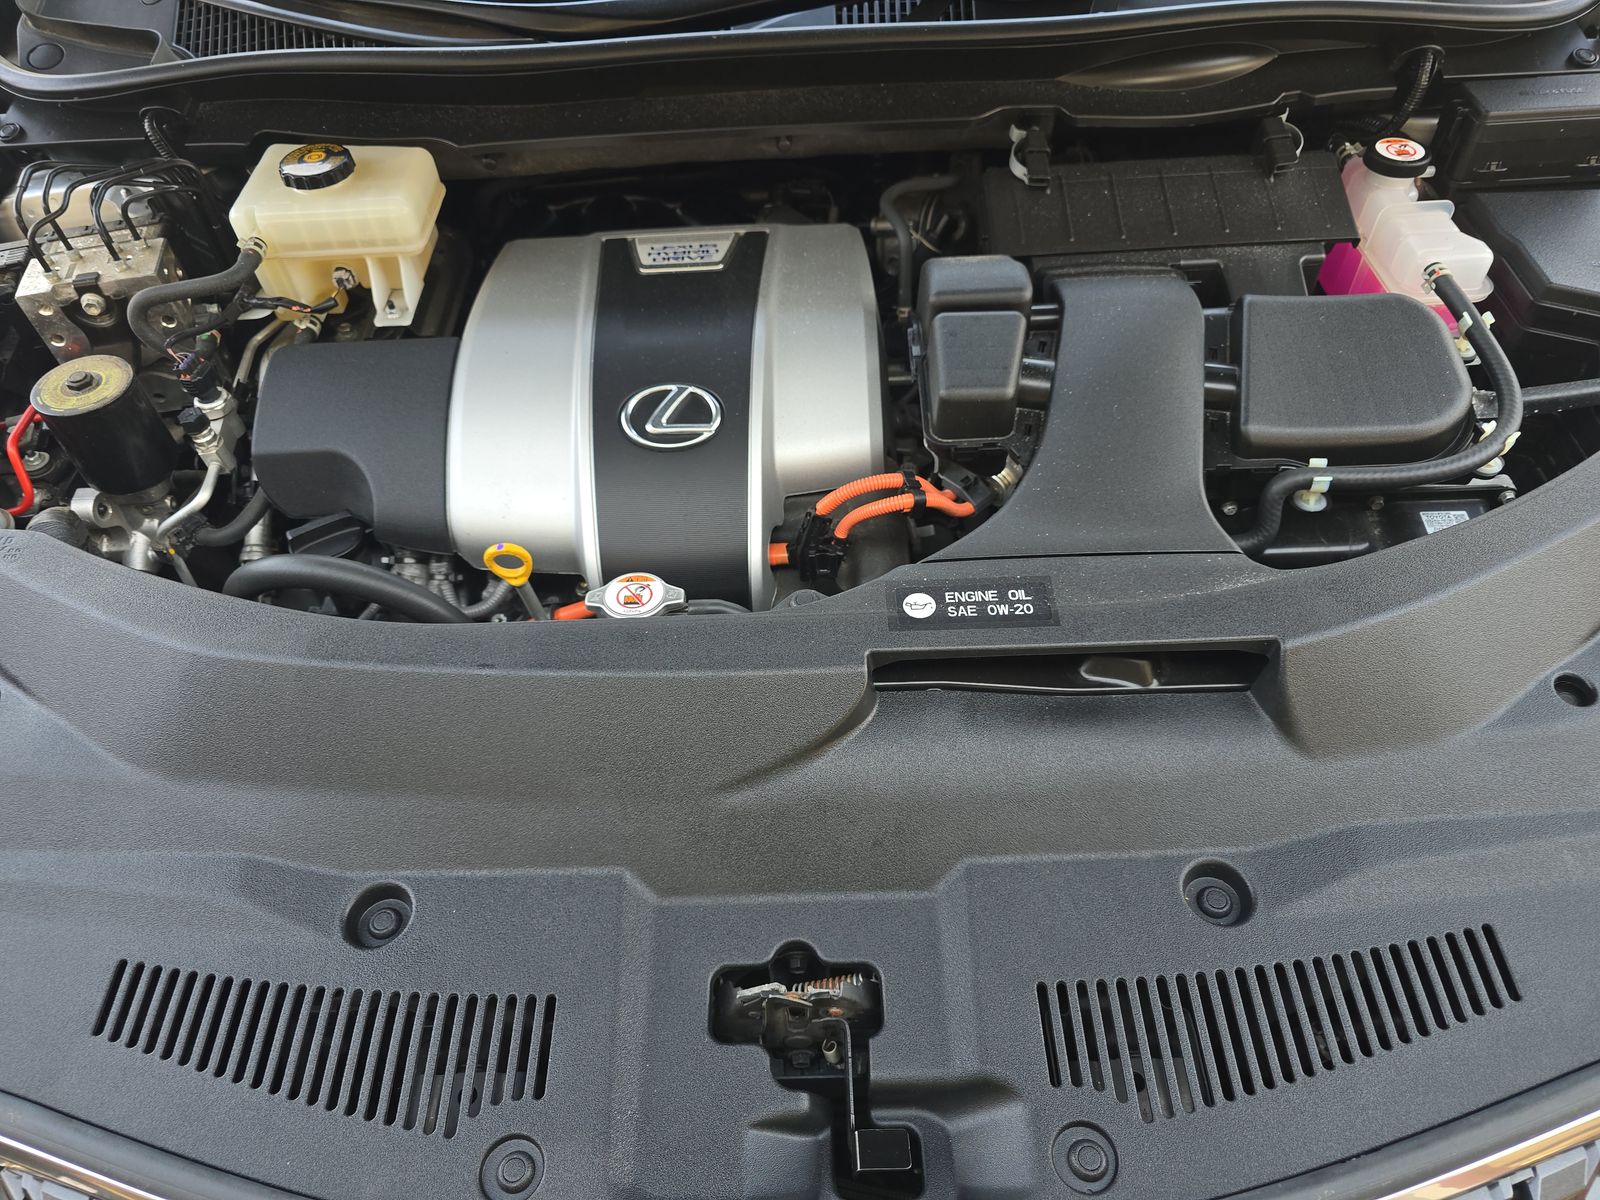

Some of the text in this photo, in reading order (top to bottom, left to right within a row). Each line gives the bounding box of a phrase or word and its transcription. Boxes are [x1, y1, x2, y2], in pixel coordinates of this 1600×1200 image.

[945, 589, 1032, 603] ENGINE OIL
[947, 604, 1034, 617] SAE 0W-20
